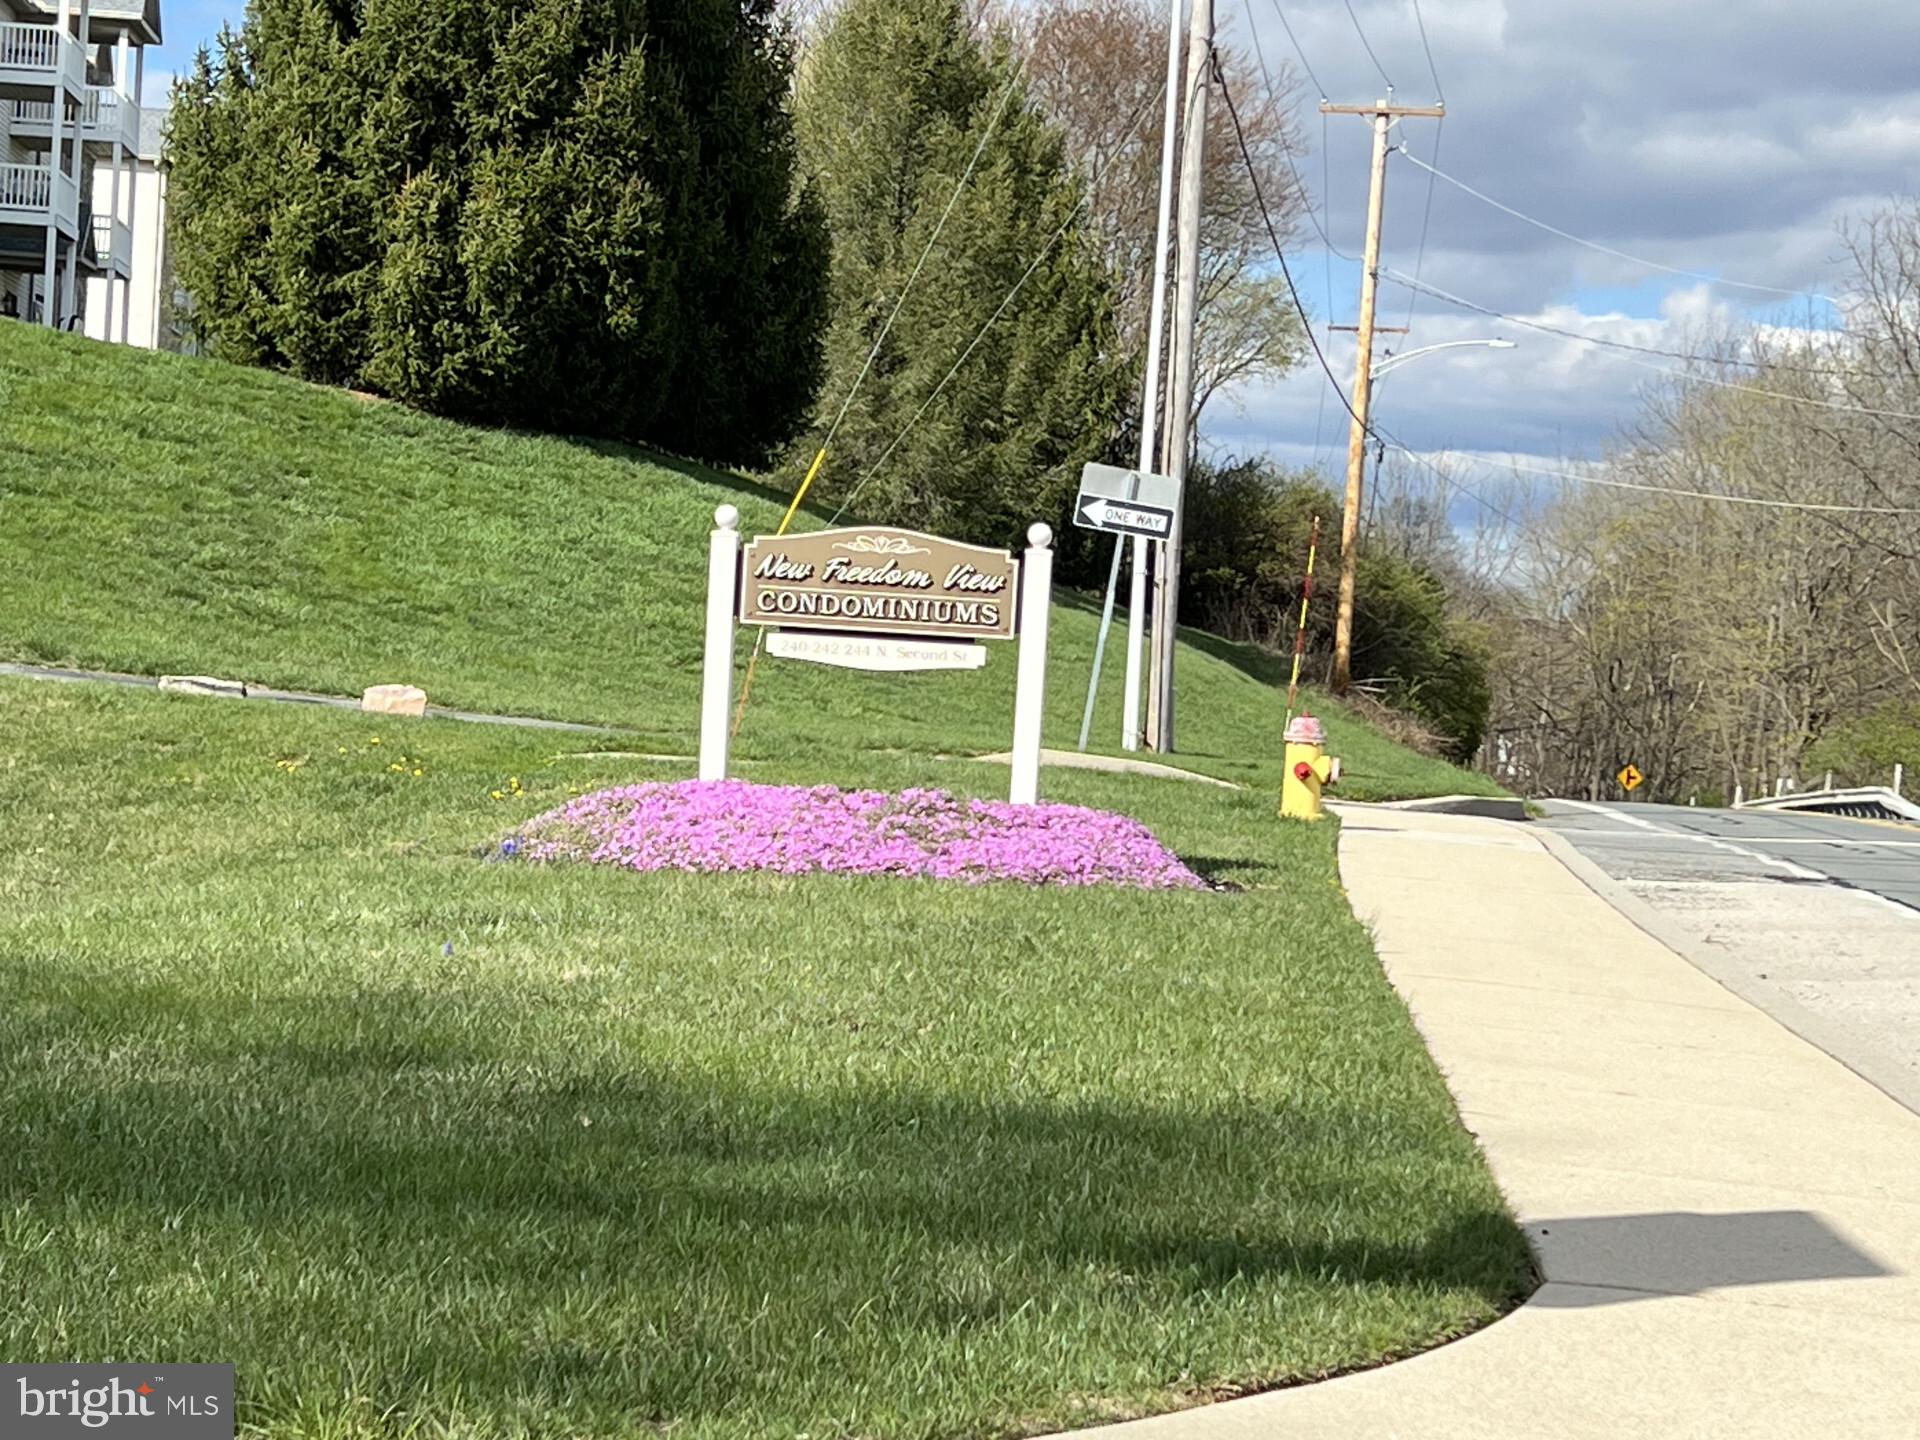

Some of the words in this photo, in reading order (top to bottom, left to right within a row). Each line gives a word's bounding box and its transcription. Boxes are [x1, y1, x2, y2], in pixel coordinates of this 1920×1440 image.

[1105, 508, 1130, 523] ONE
[1136, 513, 1161, 529] WAY
[754, 552, 815, 582] New
[821, 555, 933, 589] Freedom
[943, 563, 1007, 593] View
[757, 590, 999, 626] CONDOMINIUMS
[896, 646, 948, 661] Second
